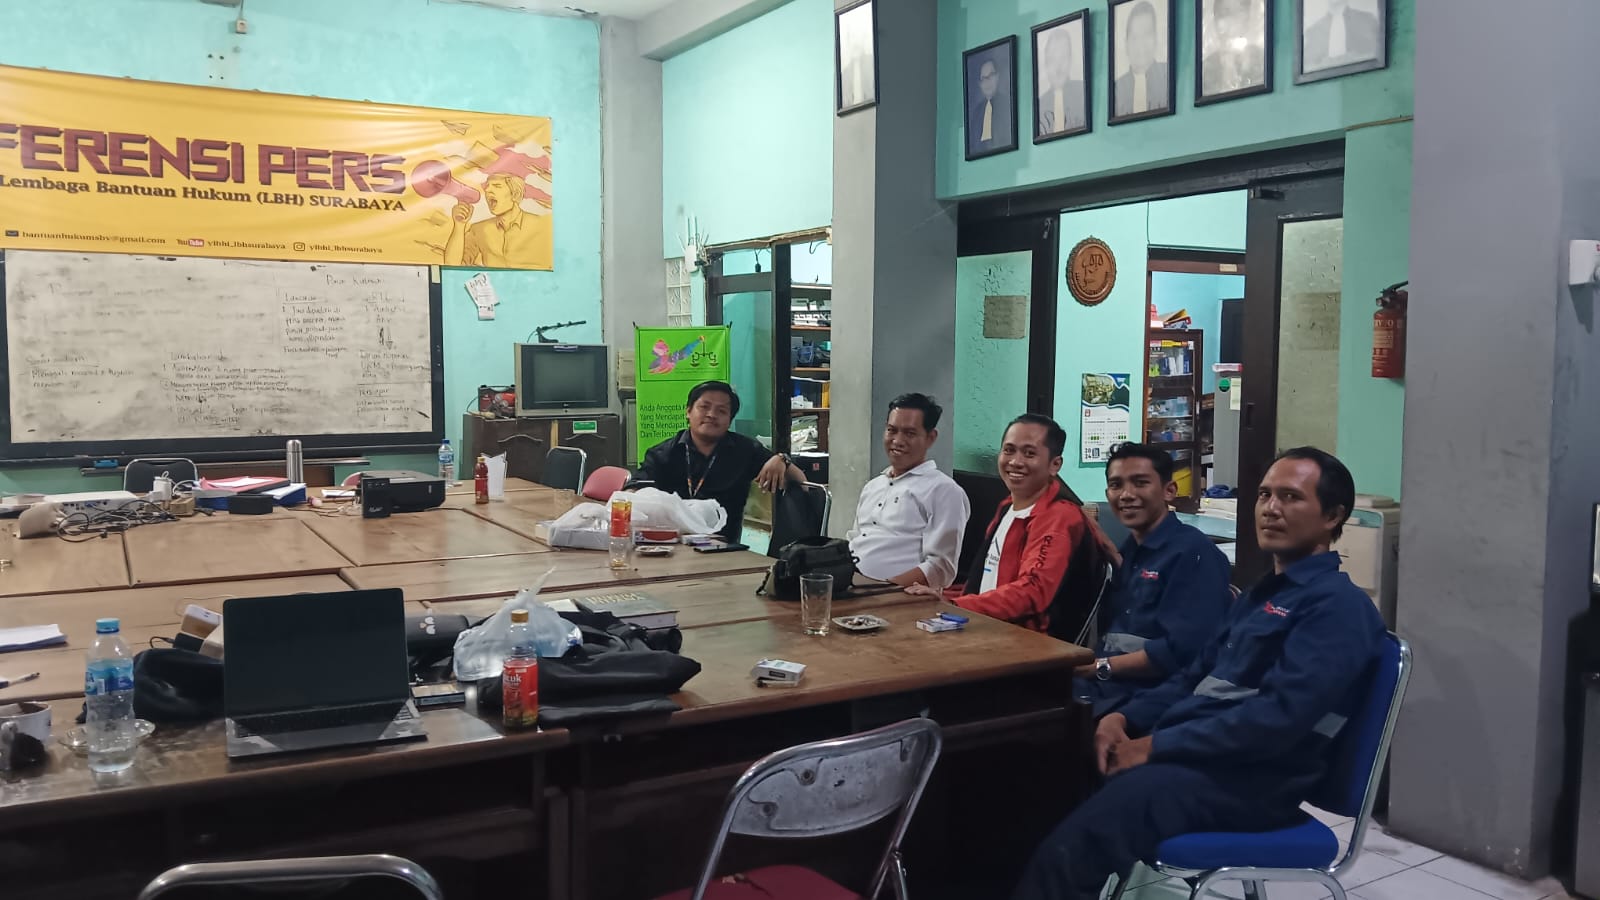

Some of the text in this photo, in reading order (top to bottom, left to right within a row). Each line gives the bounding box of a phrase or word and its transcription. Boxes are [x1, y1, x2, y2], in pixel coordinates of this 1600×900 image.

[257, 143, 406, 195] PERS
[0, 175, 406, 212] Lembaga Bantuan Hukum (LBH) SURABAYA
[639, 413, 655, 422] Yang
[639, 423, 655, 431] Yang
